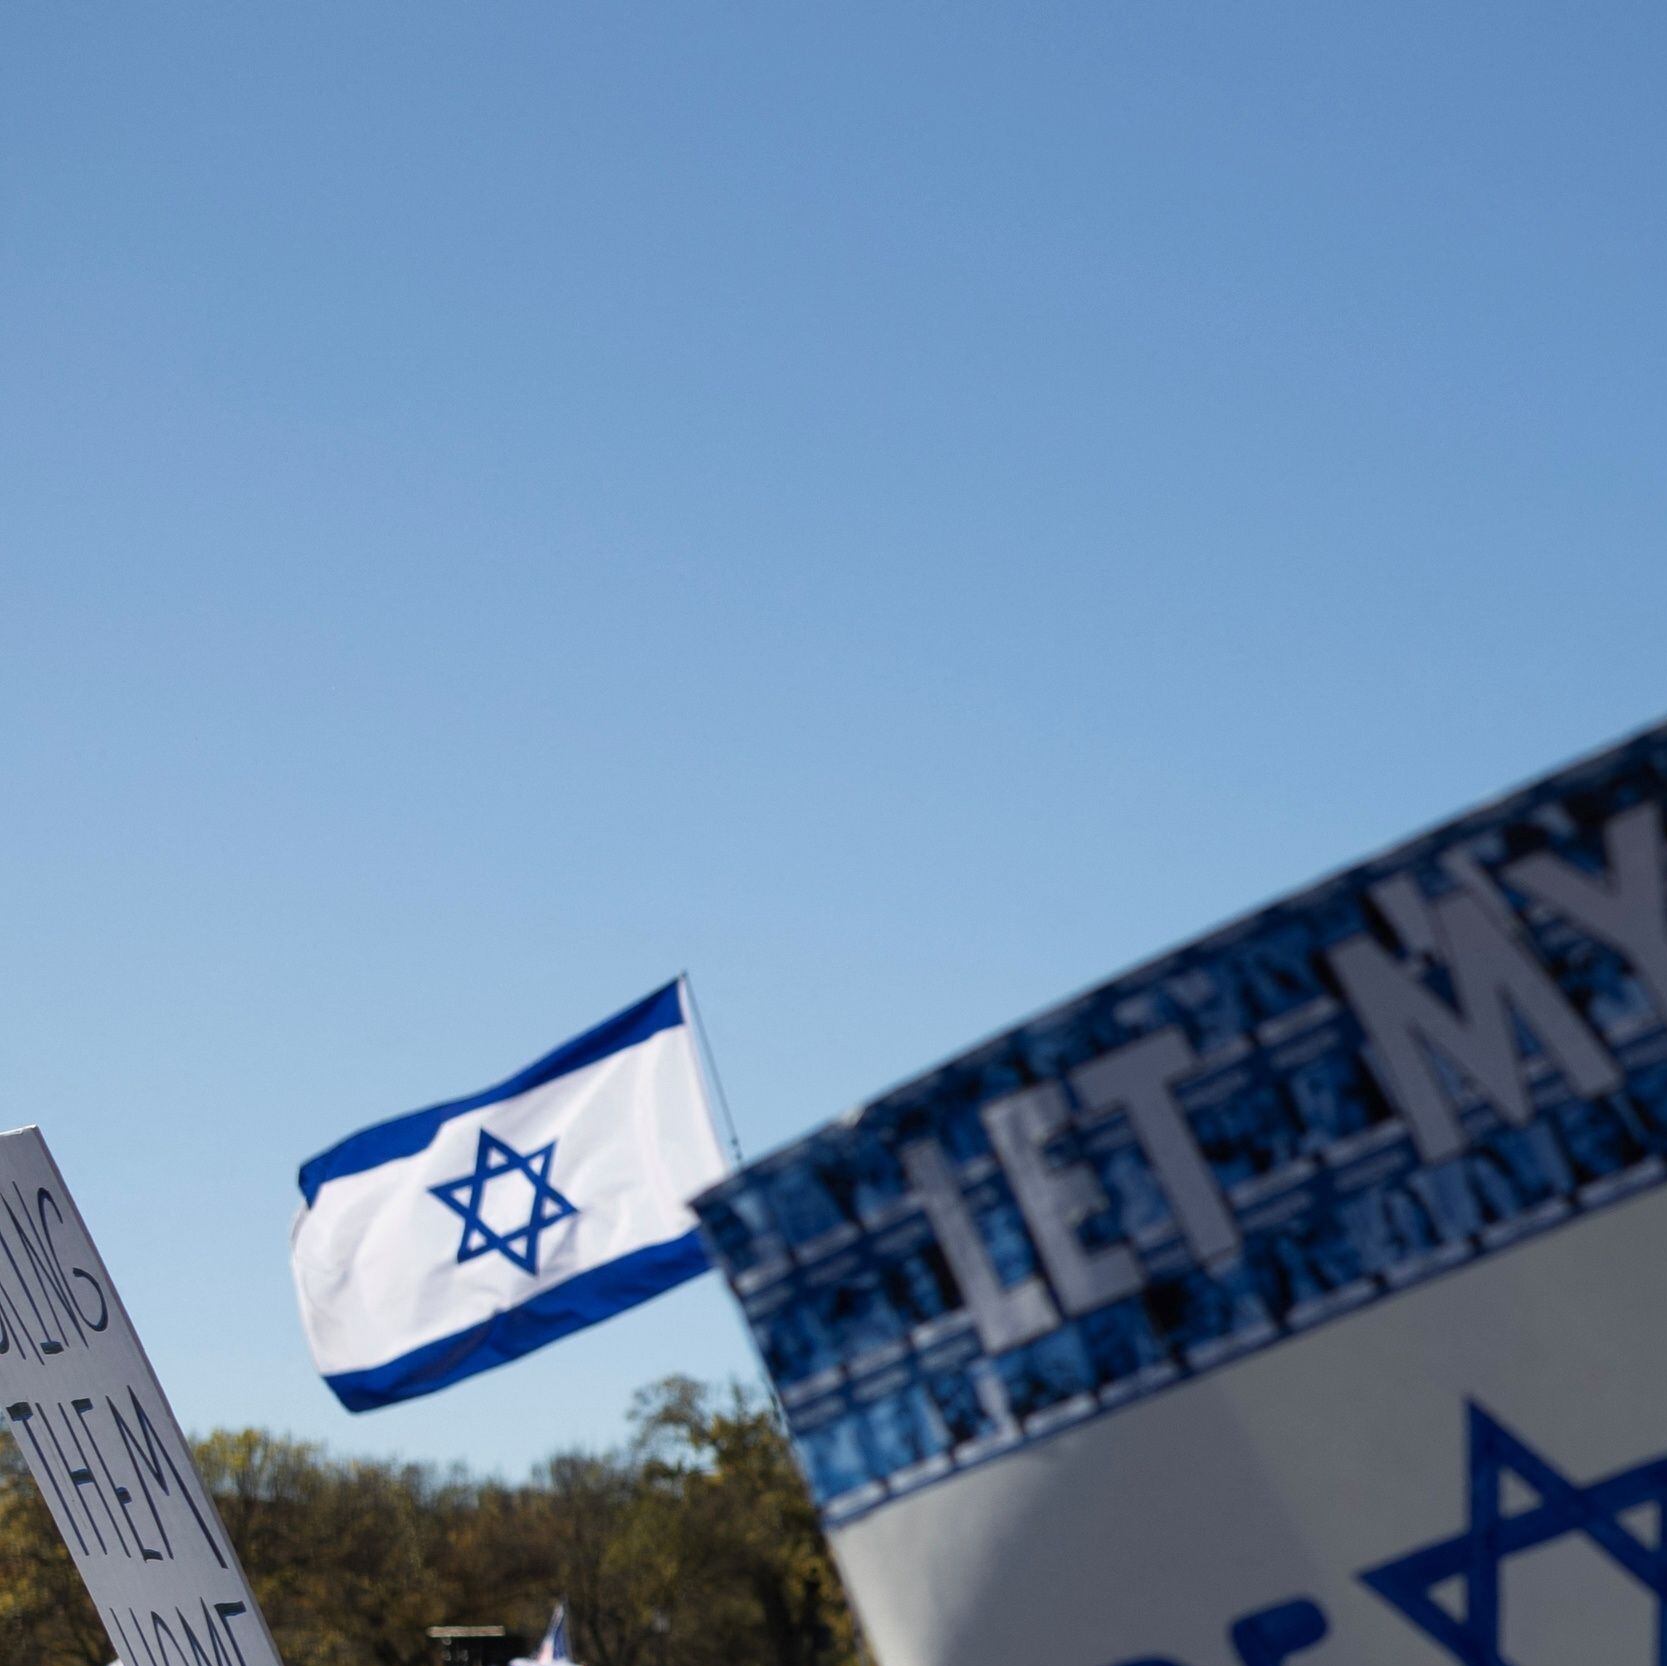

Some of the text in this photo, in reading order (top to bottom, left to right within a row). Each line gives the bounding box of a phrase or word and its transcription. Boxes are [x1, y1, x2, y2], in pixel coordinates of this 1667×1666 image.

[0, 1180, 109, 1366] ING
[898, 1024, 1242, 1353] LET
[8, 1385, 229, 1570] THEM
